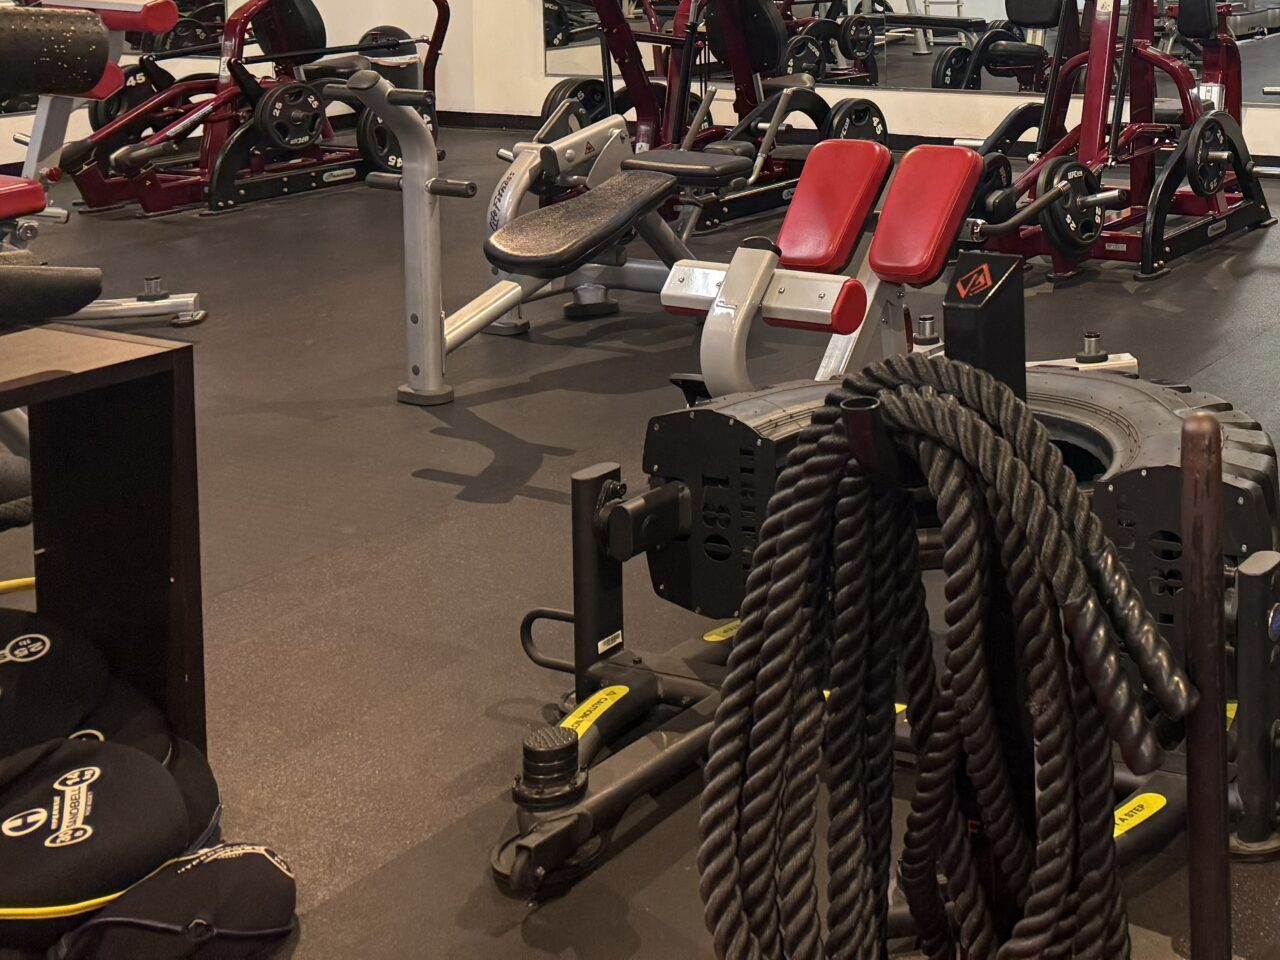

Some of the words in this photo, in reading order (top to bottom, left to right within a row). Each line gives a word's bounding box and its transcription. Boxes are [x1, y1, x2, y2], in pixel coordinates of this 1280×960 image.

[125, 73, 146, 87] 45
[273, 102, 283, 117] 25
[307, 95, 320, 109] 25
[872, 116, 883, 135] 45
[1065, 214, 1076, 231] 25
[702, 473, 731, 562] 180
[66, 771, 80, 785] 14
[66, 786, 81, 828] SANDBELL
[1119, 815, 1128, 824] A
[1124, 803, 1145, 820] STEP
